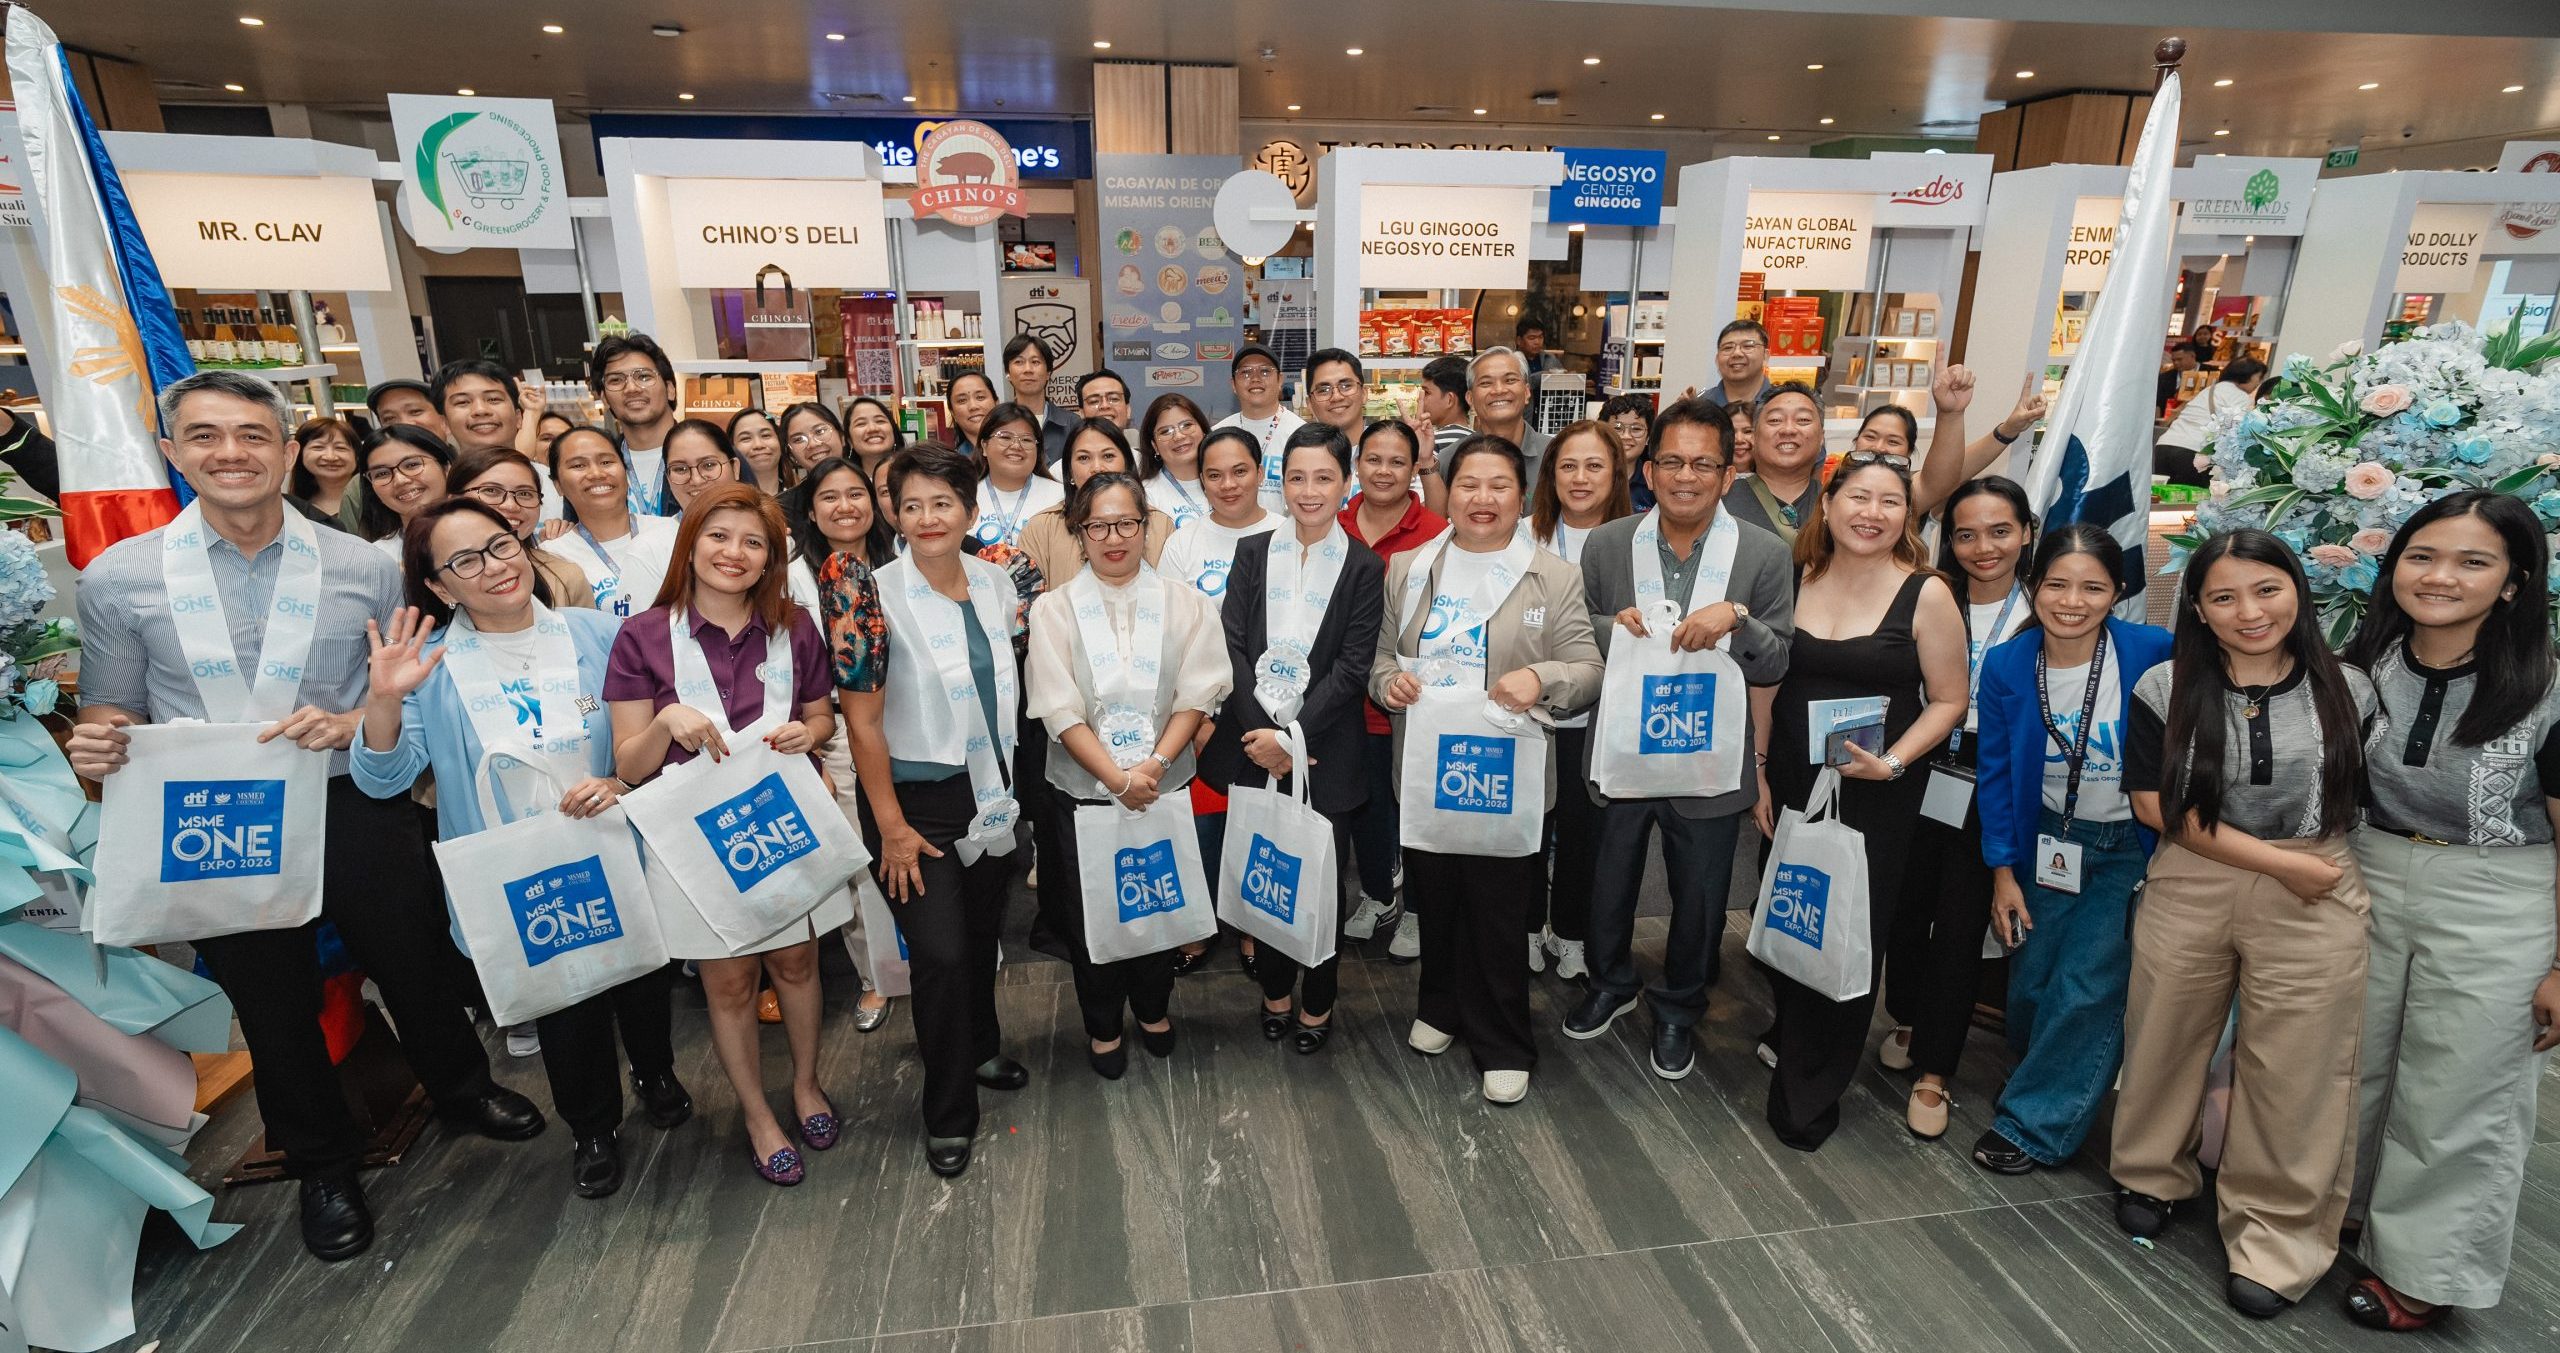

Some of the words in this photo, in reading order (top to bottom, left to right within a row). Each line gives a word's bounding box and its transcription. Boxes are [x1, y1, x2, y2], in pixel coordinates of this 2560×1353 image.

[489, 111, 545, 161] PROCESSING
[541, 163, 551, 193] FOOD
[1566, 158, 1656, 184] NEGOSYO
[1105, 177, 1176, 190] CAGAYAN
[1181, 178, 1197, 190] DE
[1202, 178, 1222, 190] OR
[1581, 184, 1635, 196] CENTER
[921, 187, 1018, 207] CHINO'S
[1104, 196, 1166, 208] MISAMIS
[1574, 196, 1641, 208] GINGOOG
[453, 208, 462, 219] S
[462, 216, 472, 226] C
[473, 203, 545, 234] GREENGROCERY
[198, 221, 247, 241] MR.
[255, 222, 323, 242] CLAV
[1380, 221, 1413, 236] LGU
[1419, 221, 1499, 237] GINGOOG
[1797, 217, 1857, 232] GLOBAL
[702, 225, 799, 244] CHINO'S
[807, 226, 859, 244] DELI
[2069, 226, 2117, 242] EENM
[2428, 232, 2477, 246] DOLLY
[1361, 241, 1445, 257] NEGOSYO
[1450, 242, 1515, 257] CENTER
[1743, 236, 1851, 250] NUFACTURING
[1763, 255, 1808, 269] CORP.
[1029, 285, 1045, 297] dti
[751, 314, 803, 323] CHINO'S
[1049, 375, 1078, 385] MERC
[692, 400, 742, 408] CHINO'S
[1050, 396, 1078, 405] MAR
[165, 532, 200, 551] ONE
[288, 539, 319, 560] ONE
[173, 596, 215, 614] ONE
[277, 600, 315, 617] ONE
[1523, 606, 1546, 623] dti
[2092, 639, 2105, 674] INDUSTRY
[192, 660, 234, 678] ONE
[263, 664, 301, 680] ONE
[1270, 663, 1297, 678] ONE
[1656, 683, 1672, 695] dti
[2085, 680, 2096, 703] TRADE
[2040, 693, 2047, 702] OF
[1650, 701, 1679, 713] MSME
[2041, 704, 2051, 726] TRADE
[2083, 703, 2090, 713] OF
[1646, 710, 1708, 739] ONE
[1112, 730, 1142, 747] ONE
[1661, 739, 1687, 747] EXPO
[1690, 737, 1707, 747] 2026
[2075, 714, 2089, 757] DEPARTMENT
[547, 739, 579, 753] ONE
[1451, 742, 1468, 754] dti
[1446, 761, 1478, 772] MSME
[1441, 770, 1509, 800] ONE
[184, 789, 209, 805] dti
[237, 792, 265, 800] MSMED
[1458, 797, 1483, 806] EXPO
[1485, 800, 1508, 808] 2026
[178, 815, 225, 829] MSME
[717, 808, 737, 828] dti
[983, 812, 1010, 828] ONE
[171, 824, 273, 862] ONE
[722, 821, 760, 849] MSME
[728, 811, 807, 872] ONE
[757, 850, 785, 871] EXPO
[786, 838, 811, 854] 2026
[200, 860, 236, 871] EXPO
[239, 858, 273, 868] 2026
[1255, 860, 1273, 878] MSME
[1120, 872, 1147, 884] MSME
[525, 879, 545, 898] dti
[1121, 871, 1177, 907] ONE
[1247, 869, 1292, 912] ONE
[1773, 885, 1803, 900] MSME
[526, 896, 566, 921] MSME
[1137, 900, 1159, 912] EXPO
[1255, 895, 1273, 909] EXPO
[527, 896, 612, 945] ONE
[1770, 894, 1821, 935] ONE
[553, 933, 585, 948] EXPO
[589, 924, 616, 938] 2026
[1784, 920, 1803, 934] EXPO
[1803, 928, 1819, 943] 2026
